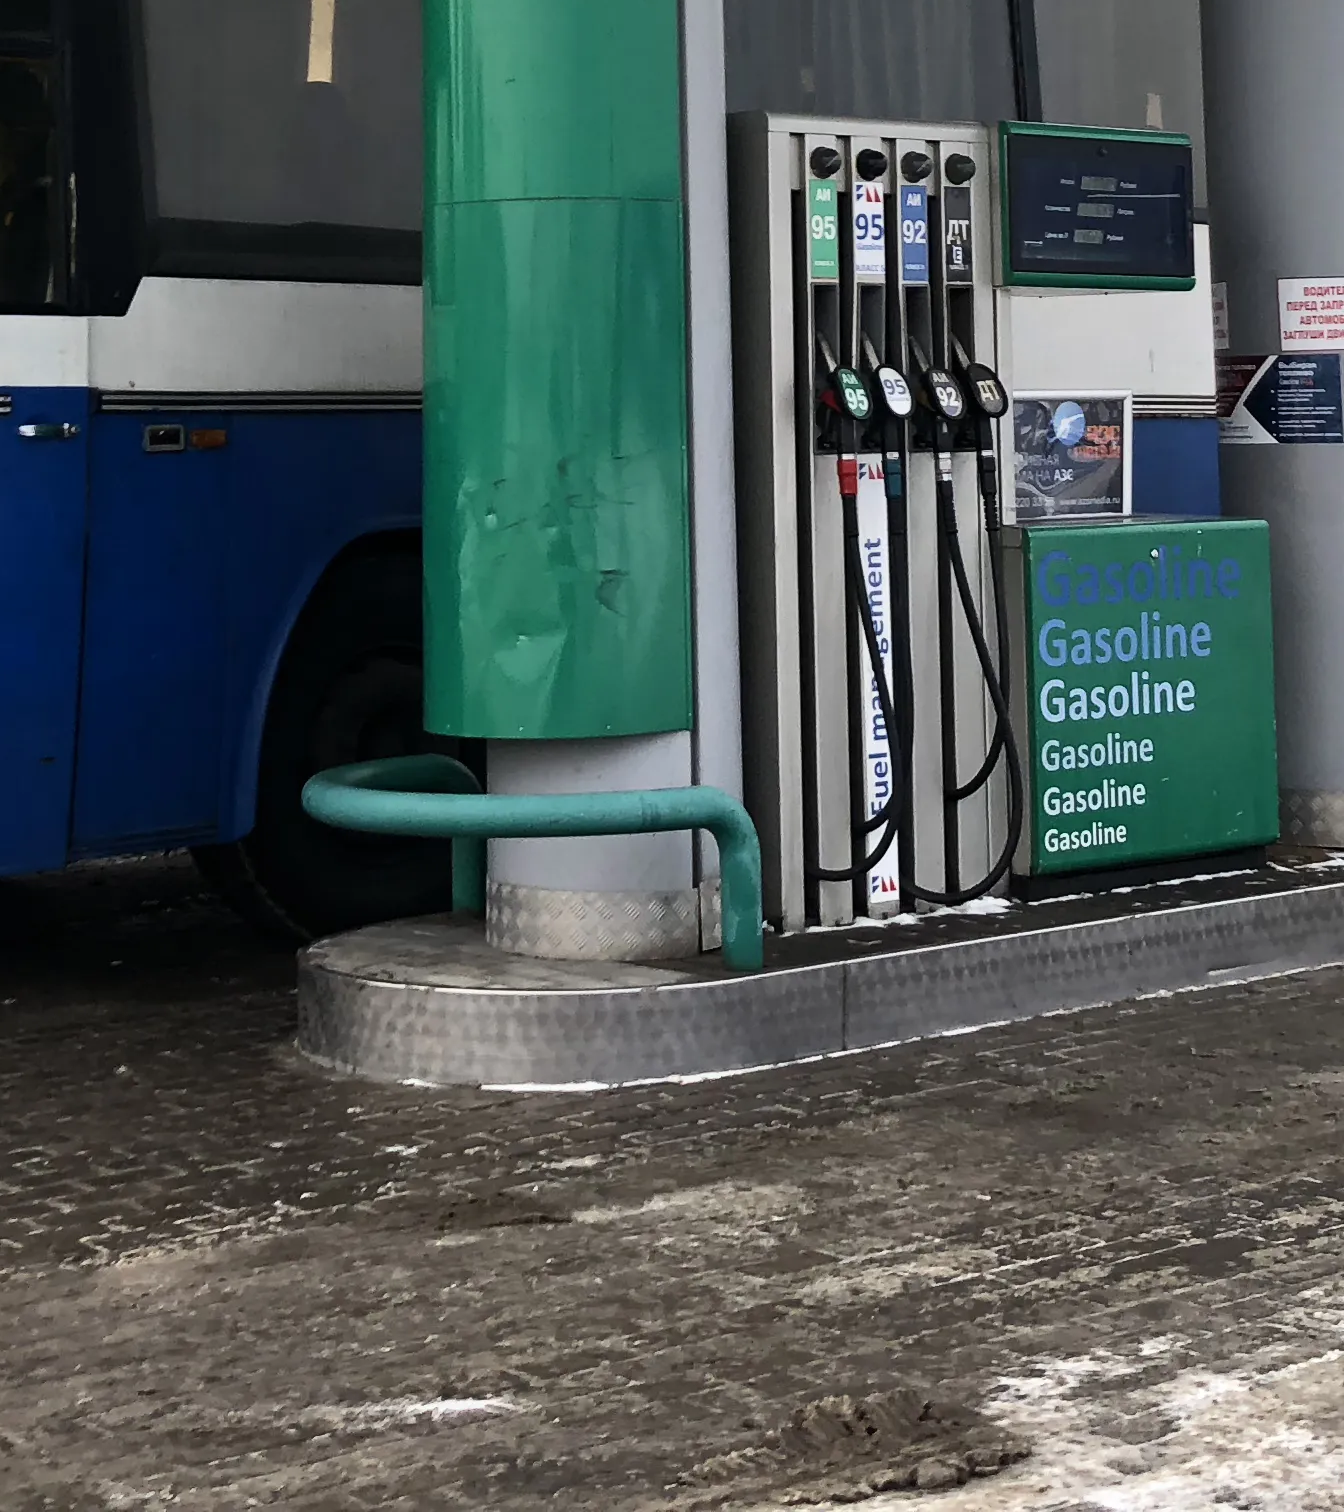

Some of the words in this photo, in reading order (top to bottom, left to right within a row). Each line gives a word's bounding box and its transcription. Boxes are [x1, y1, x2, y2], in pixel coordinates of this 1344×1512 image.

[811, 215, 836, 240] 95
[856, 213, 883, 241] 95
[902, 220, 927, 244] 92
[946, 219, 970, 245] ДТ
[1286, 300, 1317, 312] ПЕРЕД
[1283, 330, 1325, 340] ЗАГЛУШИ
[844, 387, 869, 411] 95
[883, 379, 907, 395] 95
[935, 387, 960, 407] 92
[1037, 545, 1242, 606] Gasoline
[864, 537, 890, 740] magement
[1038, 611, 1212, 667] Gasoline
[1040, 670, 1196, 723] Gasoline
[1041, 732, 1154, 772] Gasoline
[868, 752, 890, 816] Fuel
[1043, 778, 1147, 816] Gasoline
[1044, 821, 1128, 853] Gasoline
